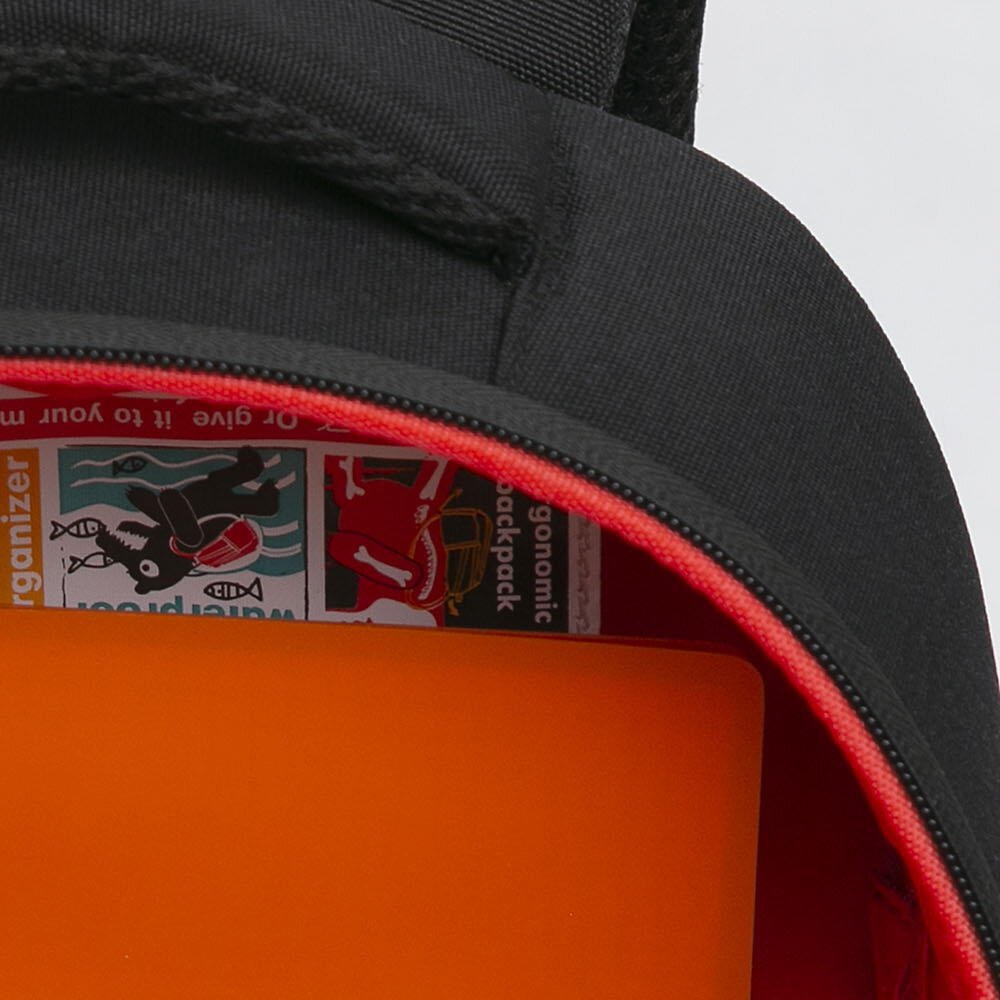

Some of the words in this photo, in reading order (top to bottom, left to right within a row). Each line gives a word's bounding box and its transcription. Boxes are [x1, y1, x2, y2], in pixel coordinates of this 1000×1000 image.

[39, 403, 103, 425] your
[114, 405, 143, 427] to
[150, 408, 171, 431] it
[193, 406, 252, 426] give
[263, 410, 298, 430] Or
[0, 456, 42, 607] rganizer
[528, 503, 559, 625] gonomic
